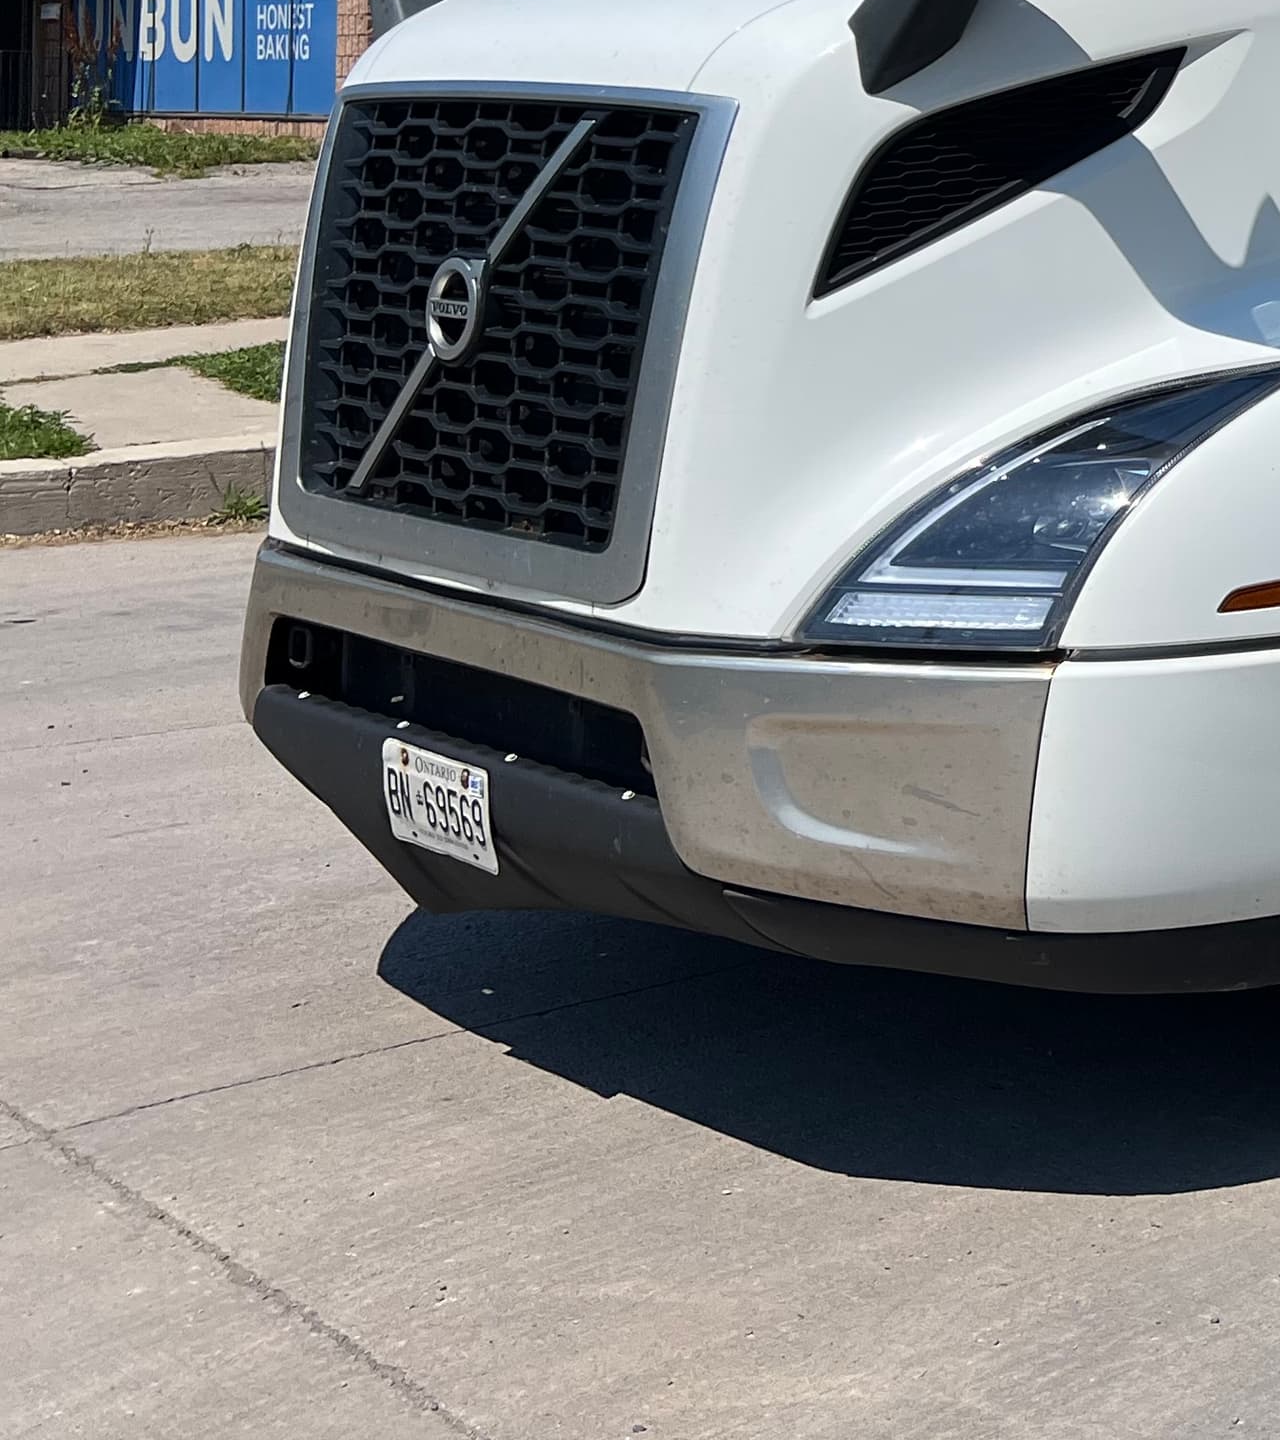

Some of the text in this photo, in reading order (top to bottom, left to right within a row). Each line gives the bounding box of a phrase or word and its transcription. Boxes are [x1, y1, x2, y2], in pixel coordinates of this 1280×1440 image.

[256, 3, 314, 30] HONEST
[256, 35, 310, 60] BAKING
[431, 301, 468, 316] VOLVO
[415, 756, 456, 782] ONTARIO
[387, 767, 488, 849] BN 69569
